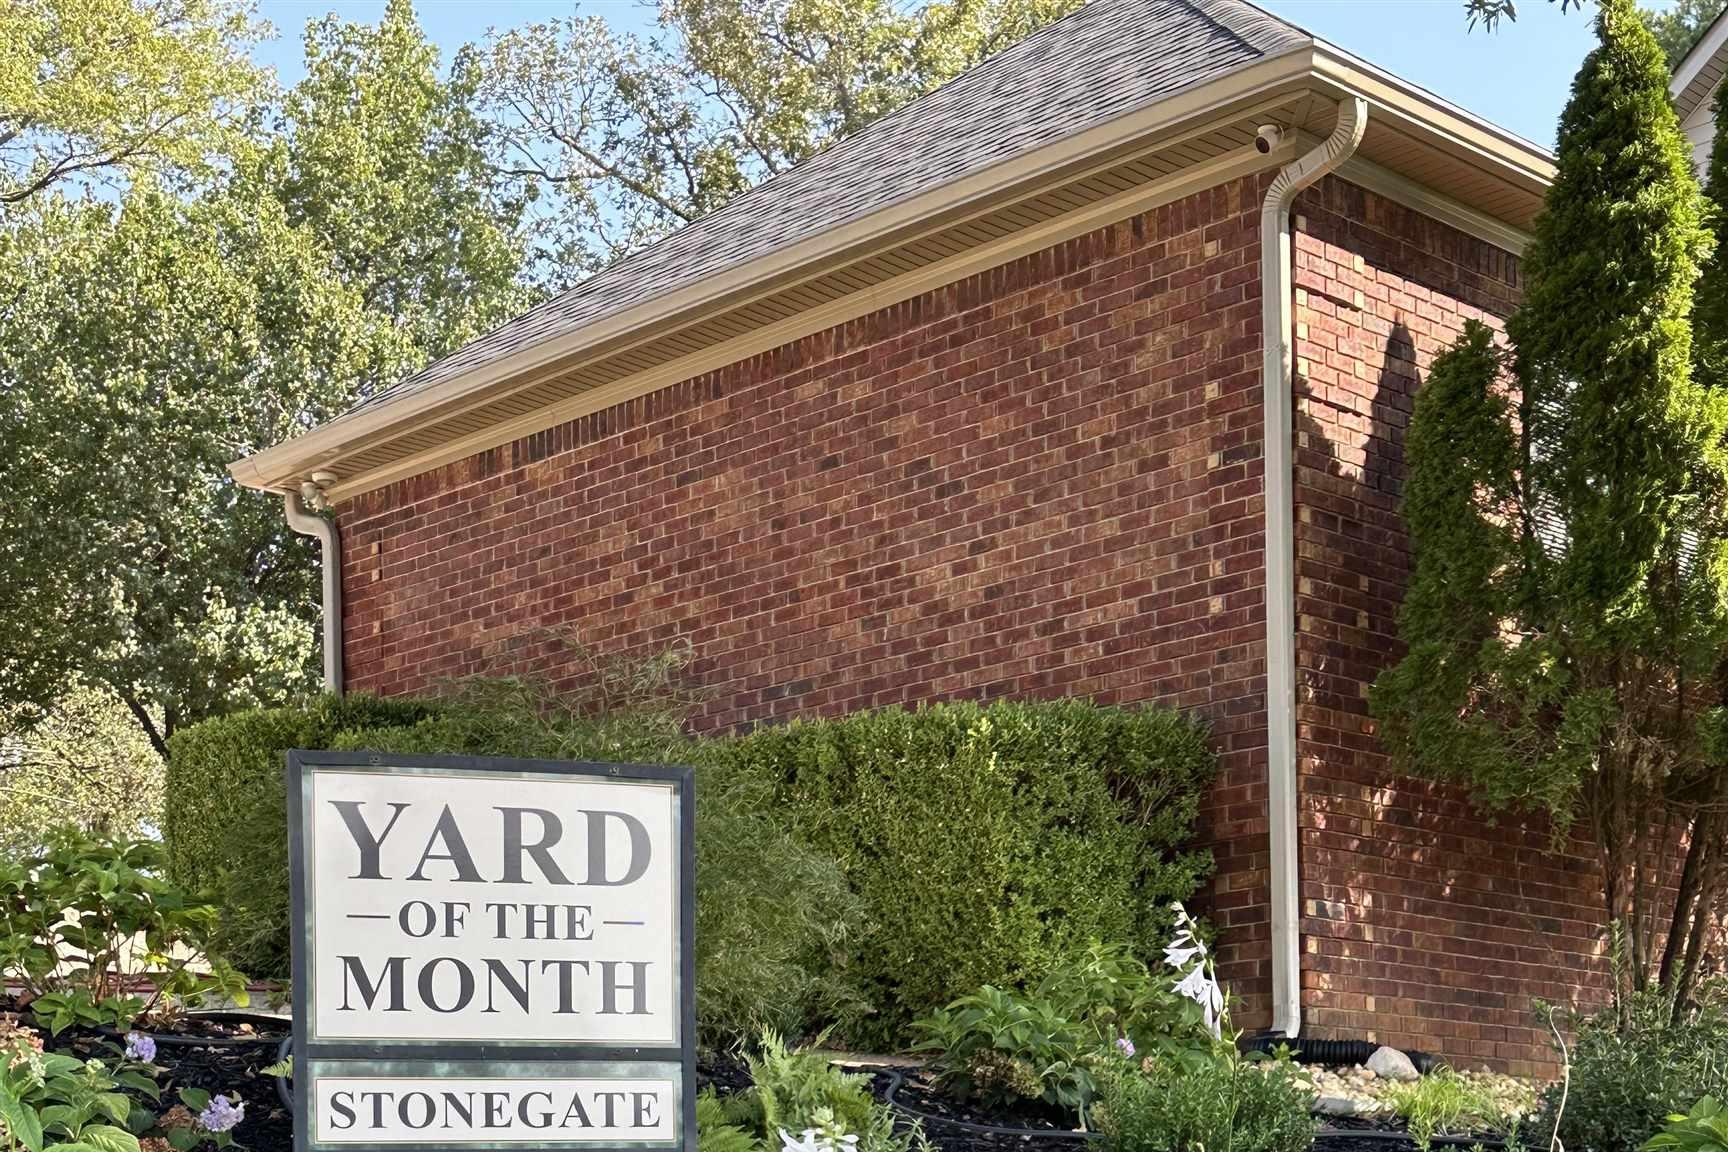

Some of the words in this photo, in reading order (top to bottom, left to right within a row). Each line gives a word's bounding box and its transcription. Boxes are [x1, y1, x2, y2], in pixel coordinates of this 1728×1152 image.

[327, 800, 653, 887] YARD
[398, 900, 471, 938] OF
[485, 903, 595, 941] THE
[335, 955, 655, 1015] MONTH
[329, 1091, 661, 1129] STONEGATE
